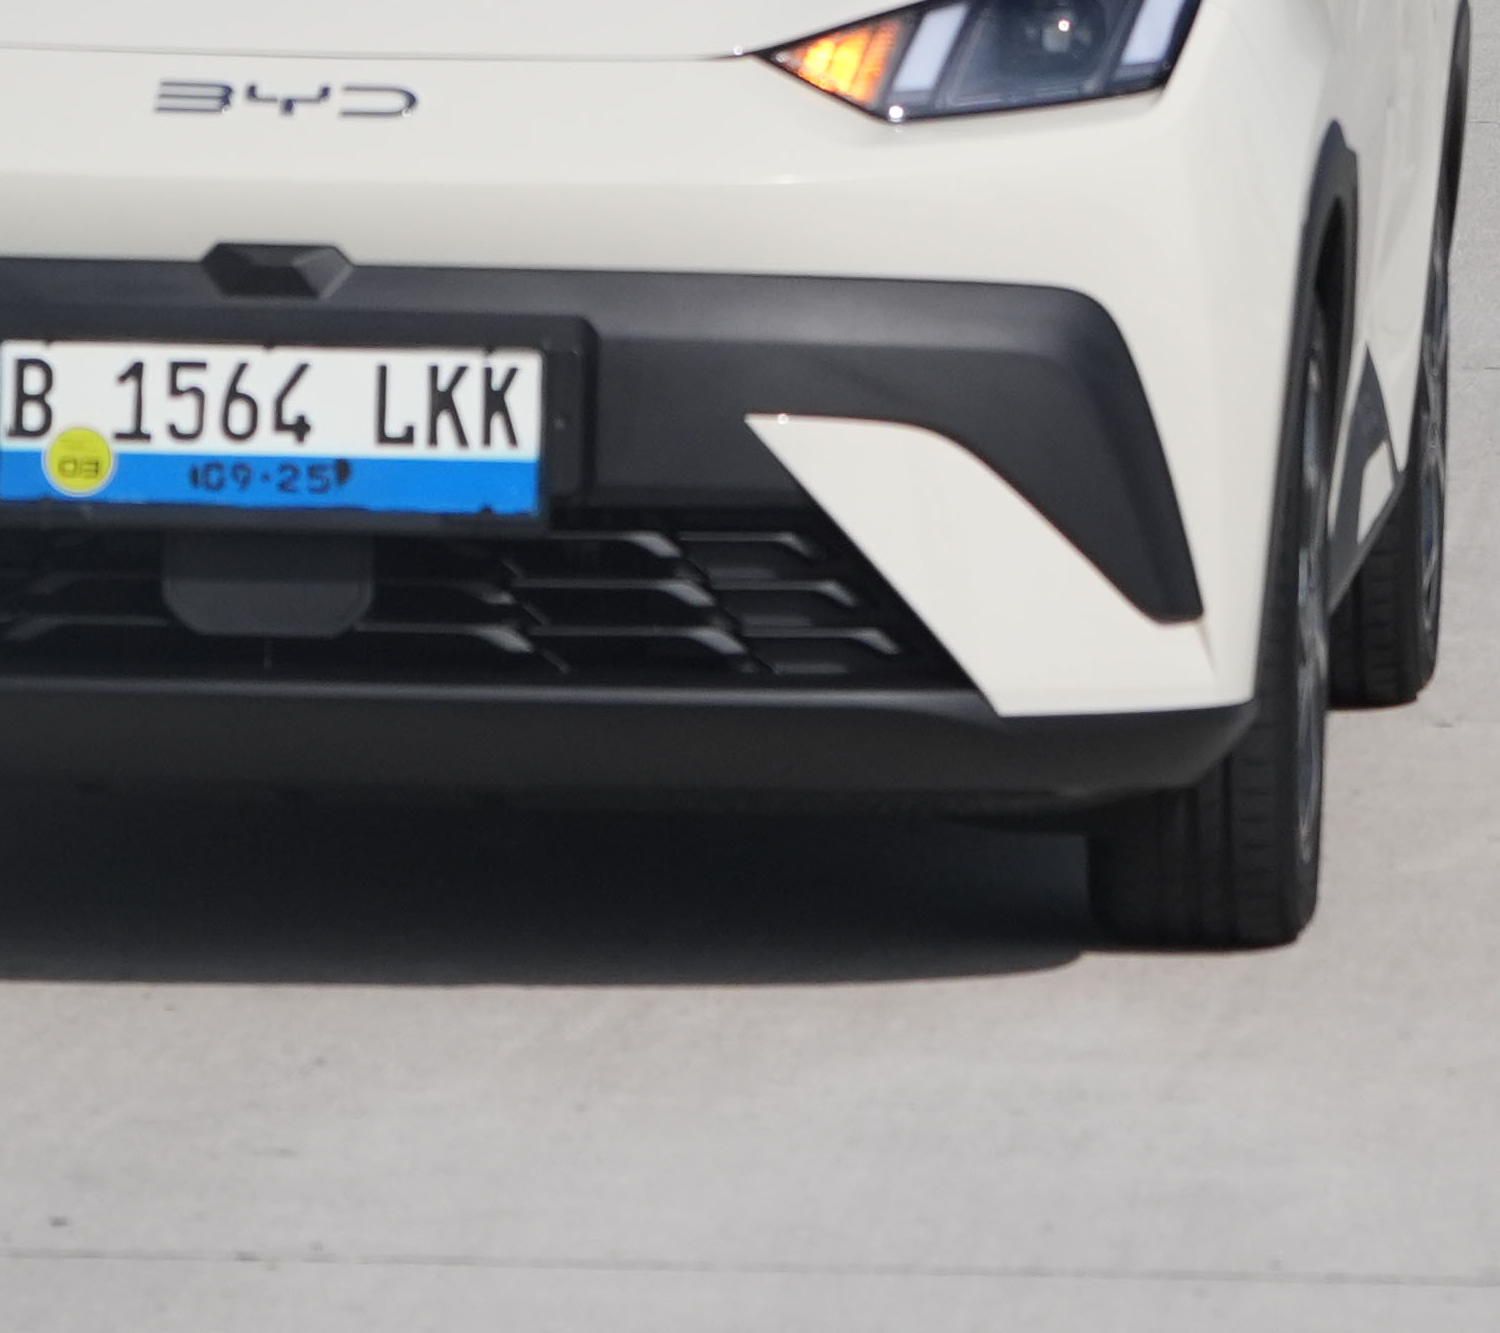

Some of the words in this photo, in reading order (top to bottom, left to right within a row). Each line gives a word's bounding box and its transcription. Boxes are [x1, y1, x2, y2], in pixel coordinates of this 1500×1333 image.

[154, 80, 418, 118] BYD
[6, 358, 54, 438] B
[113, 361, 313, 443] 1564
[374, 363, 520, 450] LKK
